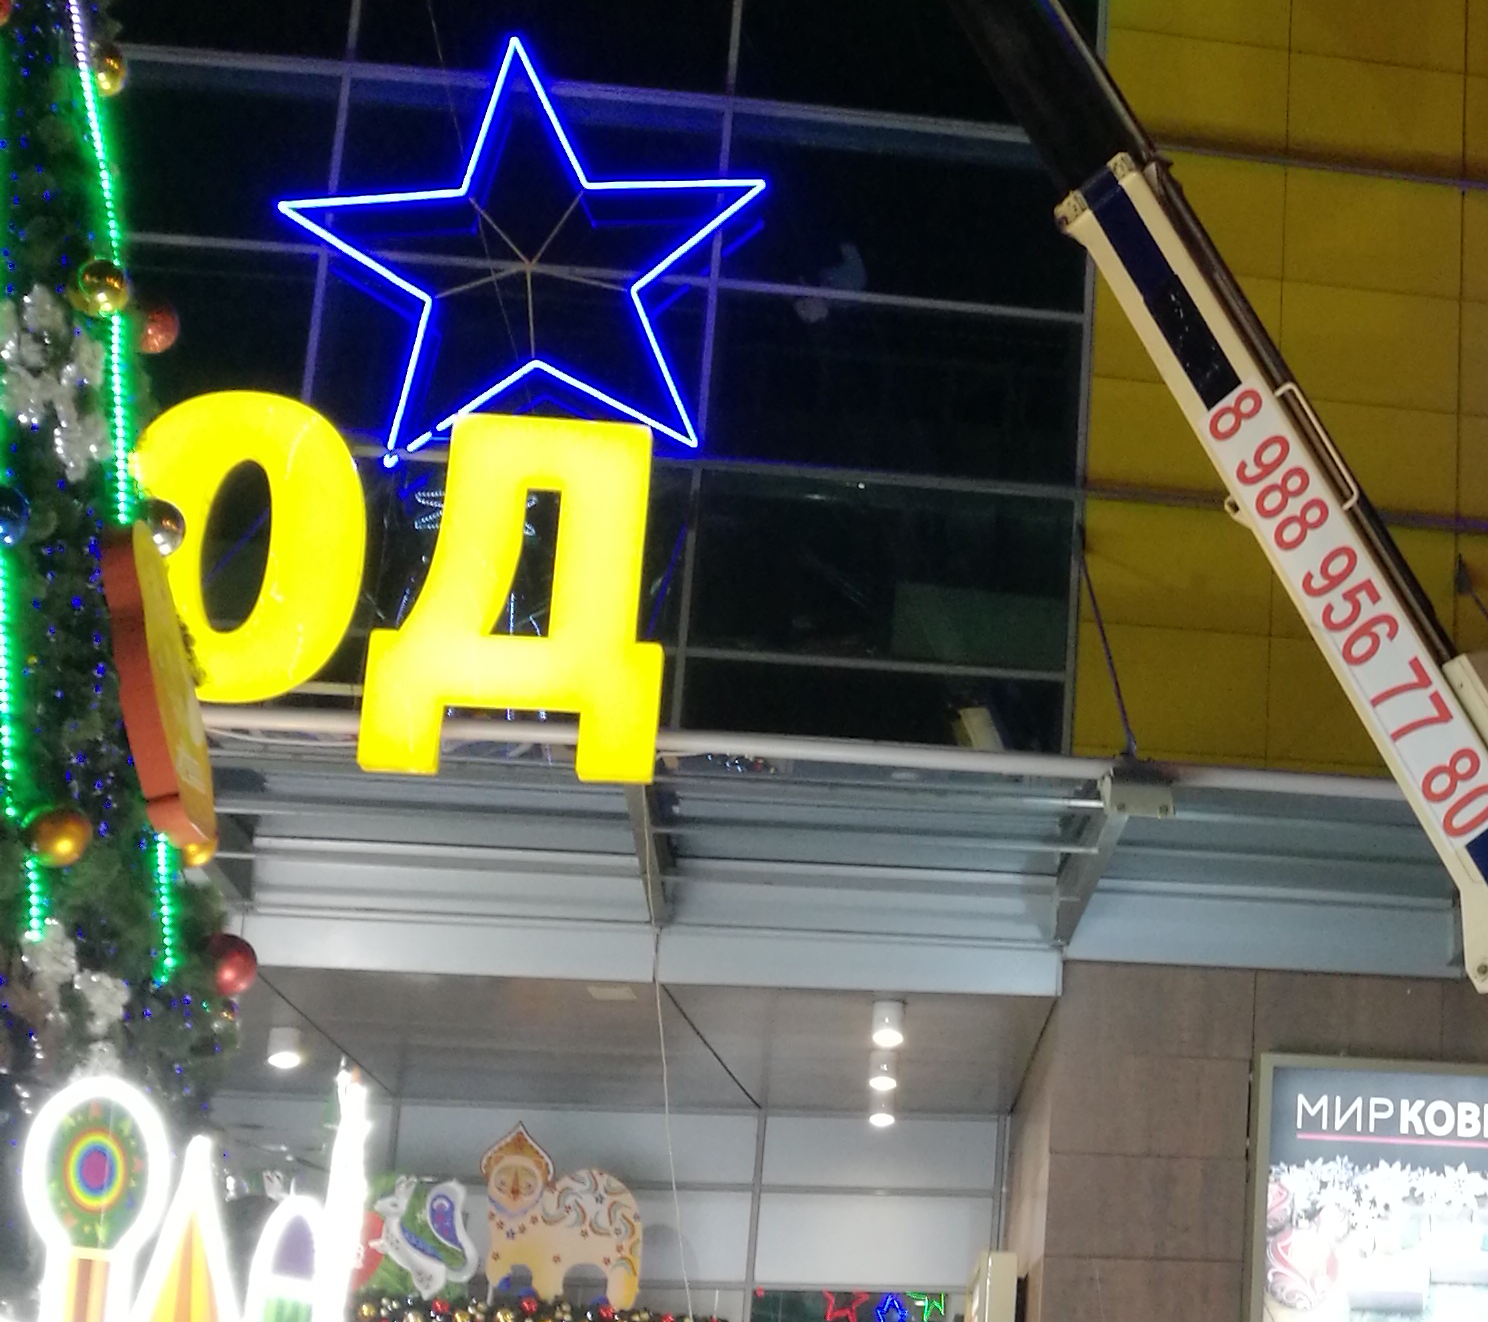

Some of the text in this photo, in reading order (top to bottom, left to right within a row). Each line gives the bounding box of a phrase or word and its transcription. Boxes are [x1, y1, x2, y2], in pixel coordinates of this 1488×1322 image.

[1208, 388, 1263, 441] 8
[1235, 435, 1330, 551] 988
[1301, 546, 1400, 666] 956
[1370, 656, 1455, 743] 77
